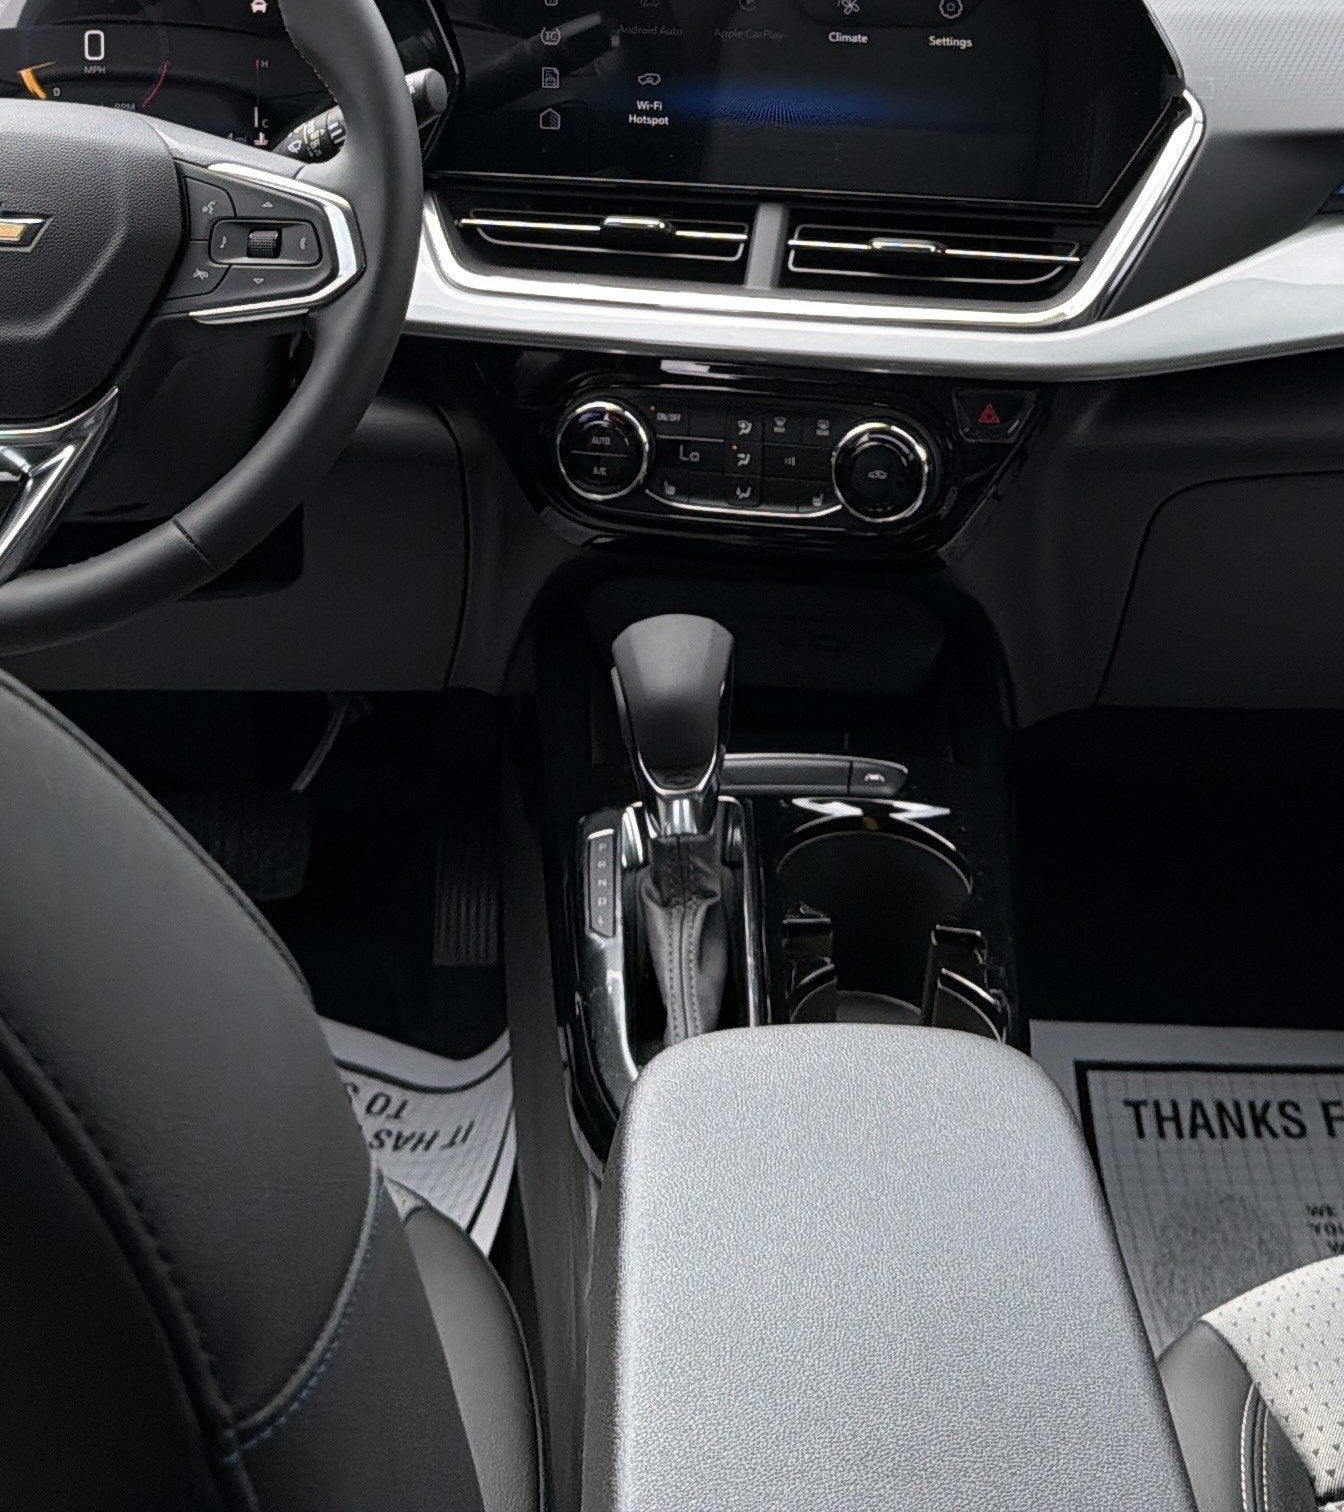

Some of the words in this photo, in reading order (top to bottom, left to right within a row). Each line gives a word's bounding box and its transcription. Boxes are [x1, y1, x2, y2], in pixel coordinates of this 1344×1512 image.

[617, 25, 657, 36] Android
[659, 26, 684, 37] Auto
[714, 28, 743, 41] Apple
[745, 29, 785, 42] CarPlay
[828, 31, 869, 44] Climate
[84, 29, 105, 61] 0
[928, 35, 973, 50] Settings
[84, 65, 107, 75] MPH
[260, 59, 269, 68] H
[114, 101, 136, 110] RPM
[636, 100, 663, 111] Wi-Fi
[628, 114, 669, 128] Hotspot
[591, 436, 611, 446] AUTO
[678, 444, 701, 463] Lo
[365, 1092, 409, 1120] TO
[1123, 1098, 1308, 1140] THANKS
[368, 1128, 441, 1153] HAS
[439, 1120, 475, 1151] IT
[1307, 1203, 1336, 1218] WE
